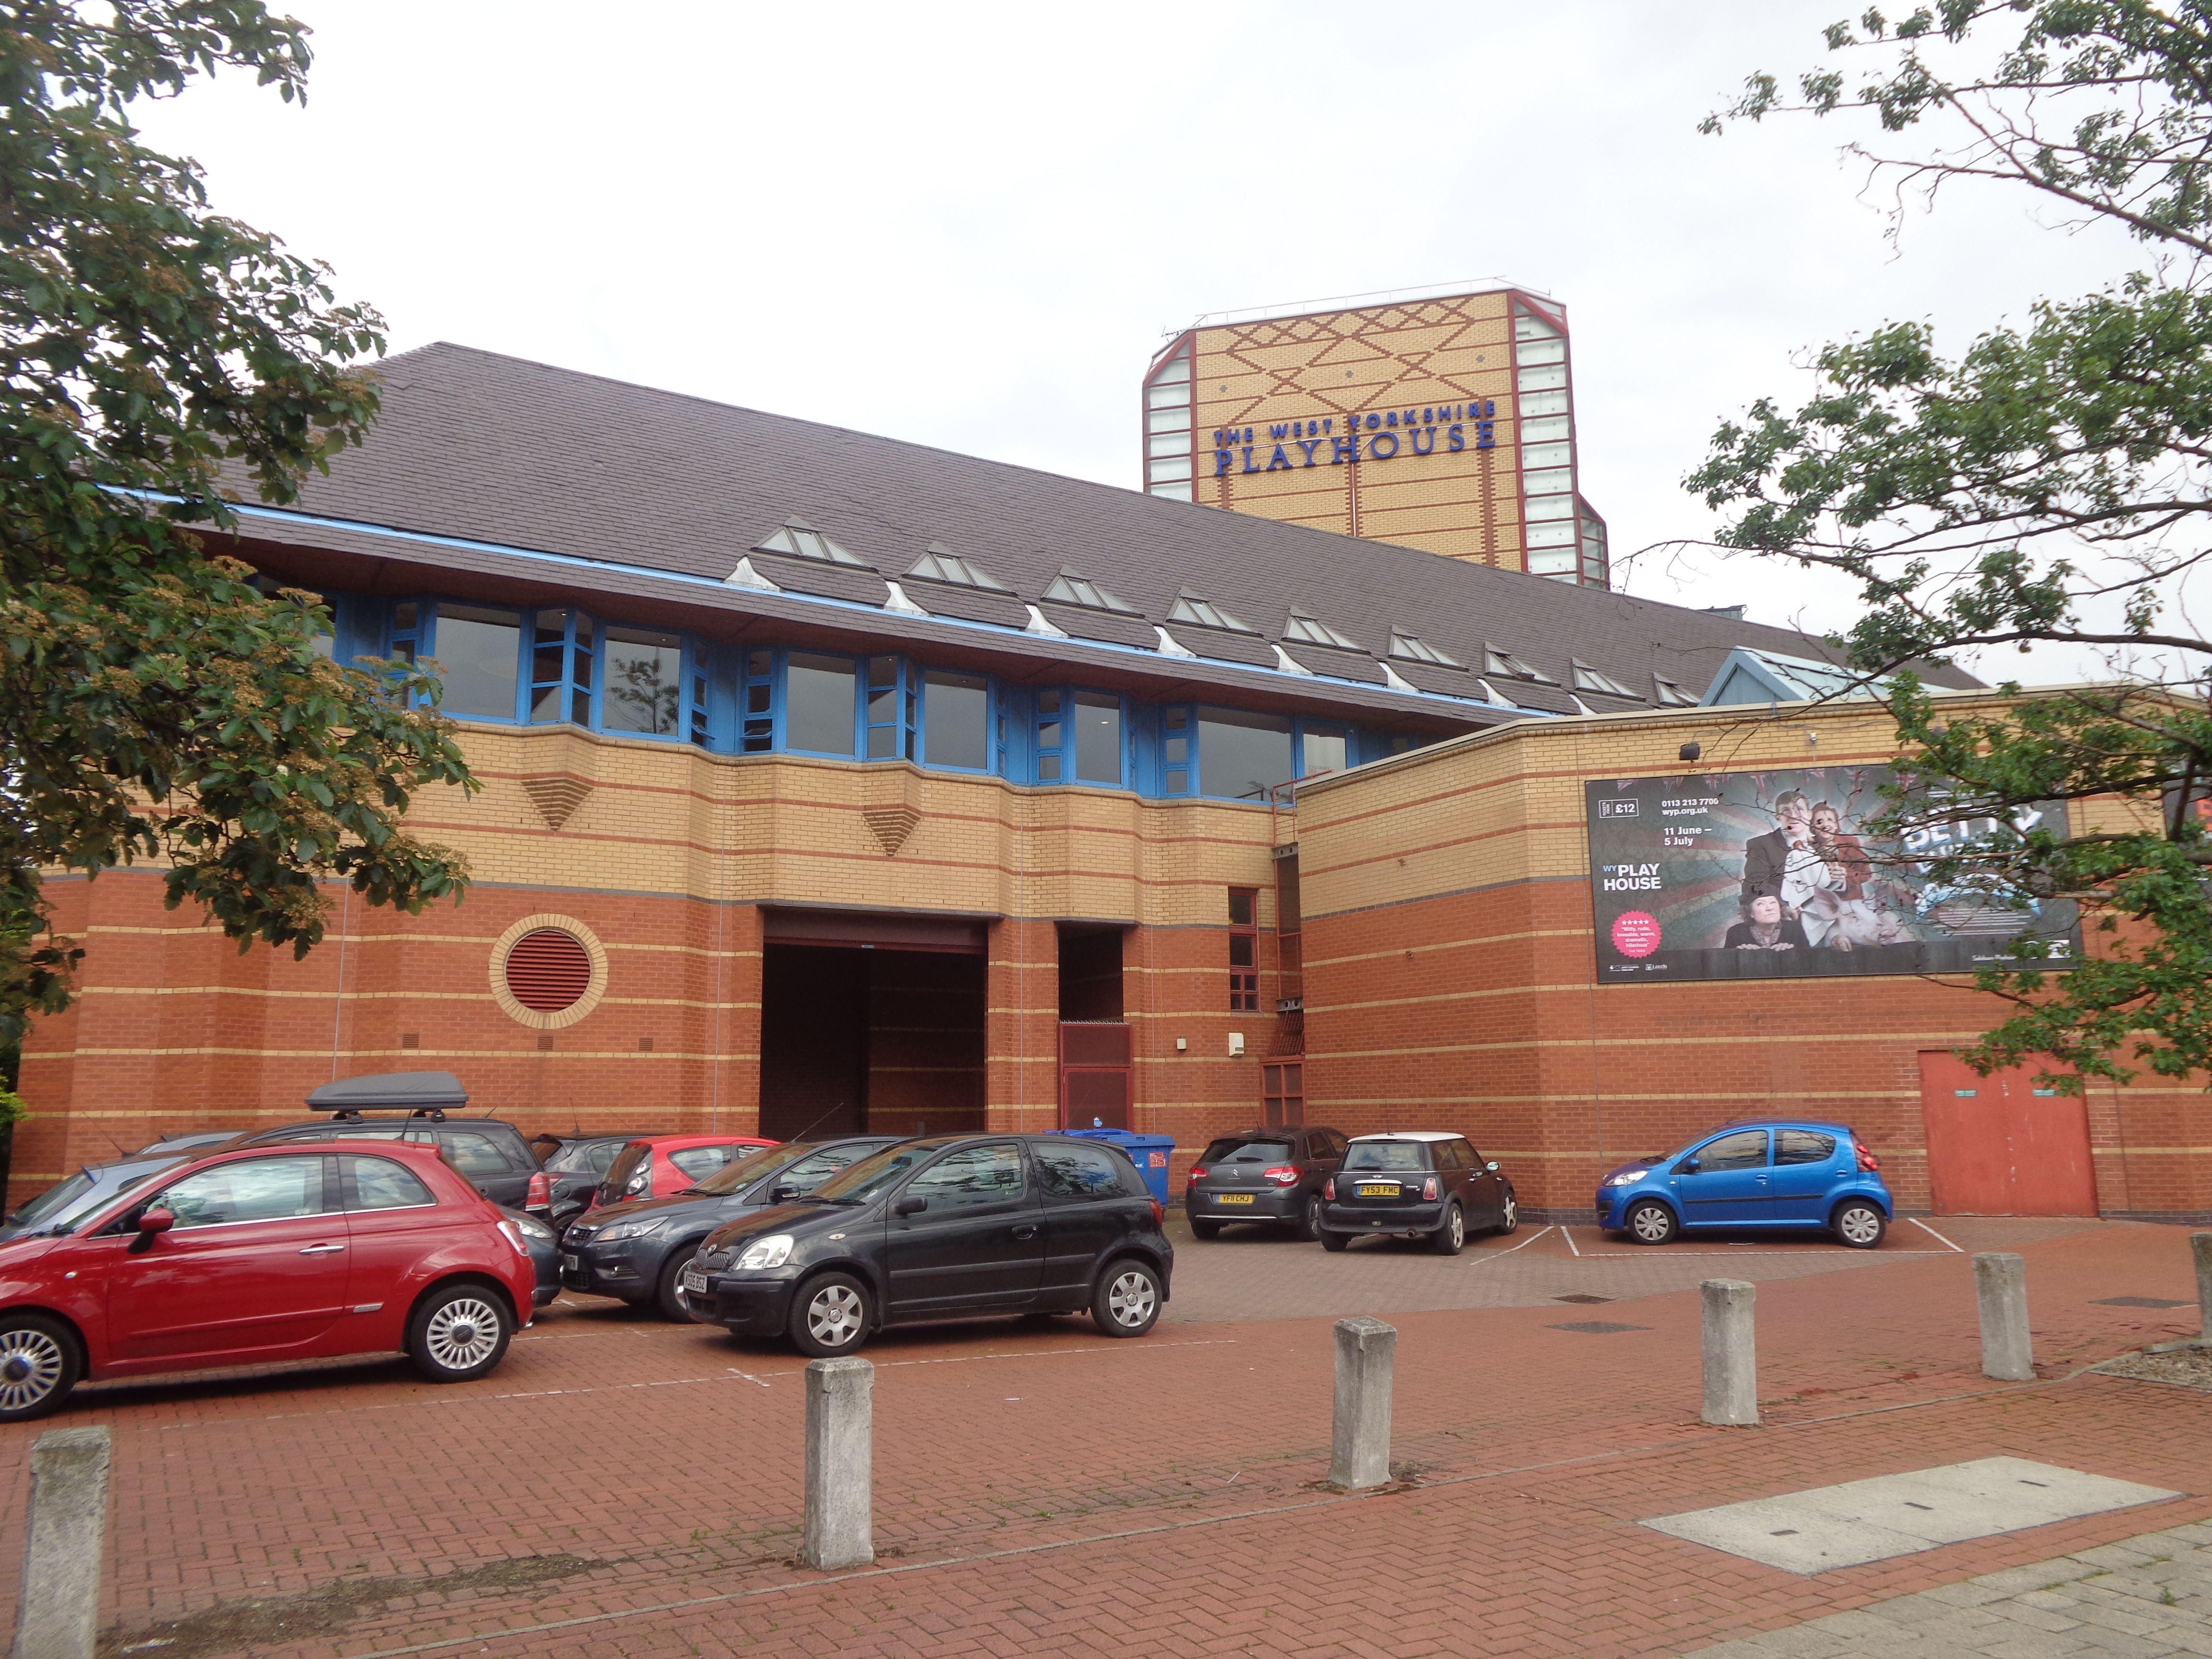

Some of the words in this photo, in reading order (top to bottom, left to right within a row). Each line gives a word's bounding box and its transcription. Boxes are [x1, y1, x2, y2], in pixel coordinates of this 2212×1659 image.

[1214, 428, 1253, 445] THE
[1270, 419, 1332, 439] WEST
[1347, 400, 1495, 430] YORKSHIRE
[1214, 421, 1495, 476] PLAYHOUSE
[1615, 804, 1635, 813] £12
[1662, 806, 1708, 816] wyp.org.uk
[1664, 827, 1674, 835] 11
[1677, 826, 1702, 835] June
[1664, 837, 1671, 845] 5
[1673, 836, 1694, 846] July
[1604, 877, 1662, 891] HOUSE
